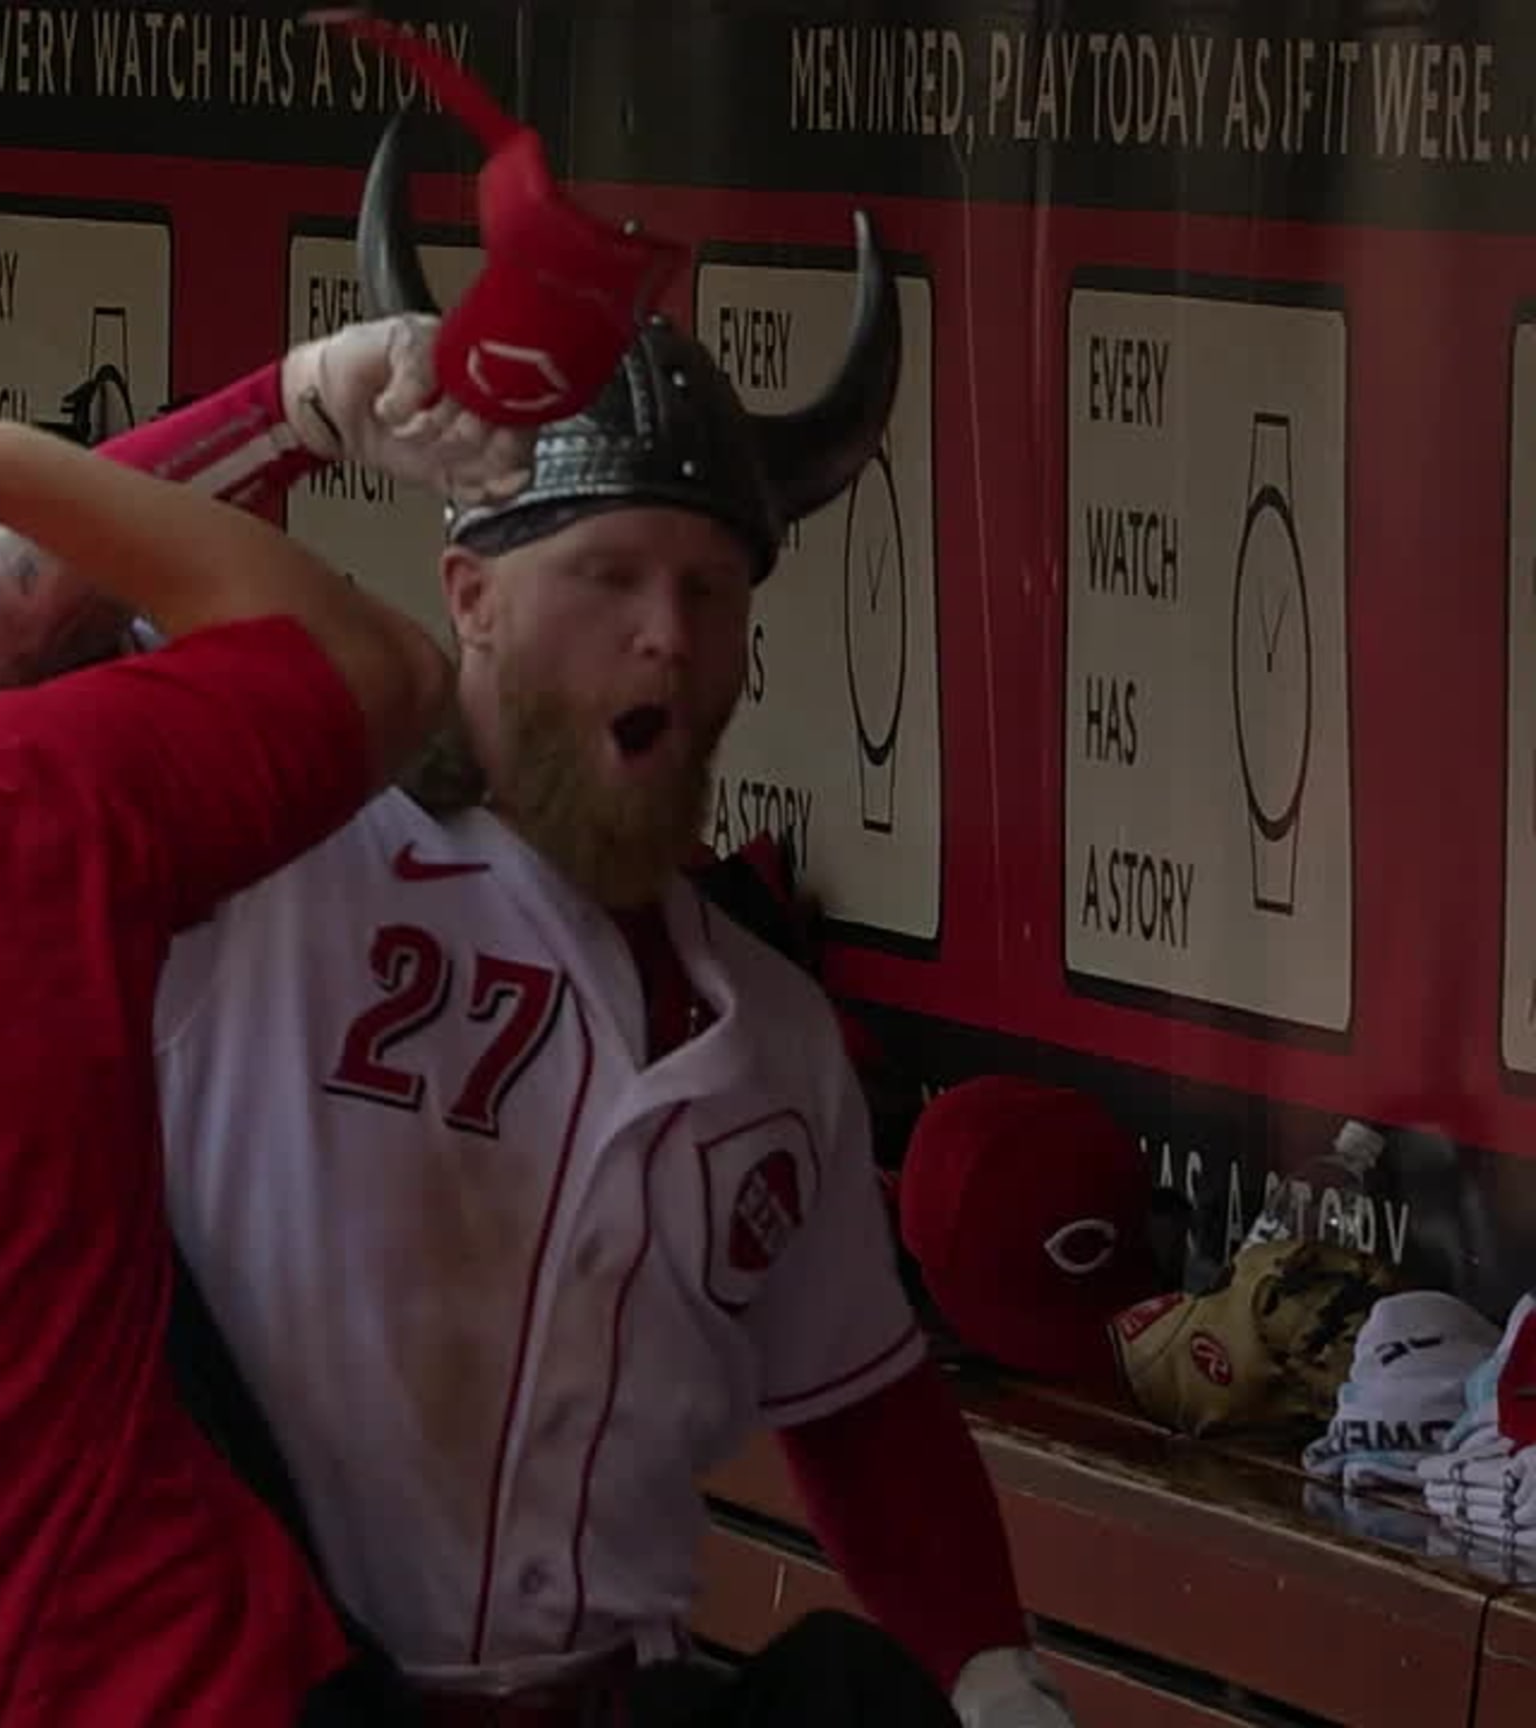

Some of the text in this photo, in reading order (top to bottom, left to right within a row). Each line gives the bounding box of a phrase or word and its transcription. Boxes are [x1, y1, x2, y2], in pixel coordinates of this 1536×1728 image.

[92, 8, 213, 101] WATCH
[229, 12, 295, 107] HAS
[312, 20, 334, 108] A
[789, 26, 859, 132] MEN
[866, 26, 896, 133] IN
[902, 28, 975, 155] RED,
[988, 31, 1081, 142] PLAY
[1089, 32, 1213, 148] TODAY
[1223, 37, 1271, 151] AS
[1281, 38, 1315, 153] IF
[1322, 40, 1361, 155] IT
[720, 306, 792, 390] EVERY
[1090, 335, 1169, 428] EVERY
[1087, 506, 1178, 604] WATCH
[1086, 674, 1137, 766] HAS
[1081, 844, 1195, 949] A STORY
[322, 923, 568, 1140] 27
